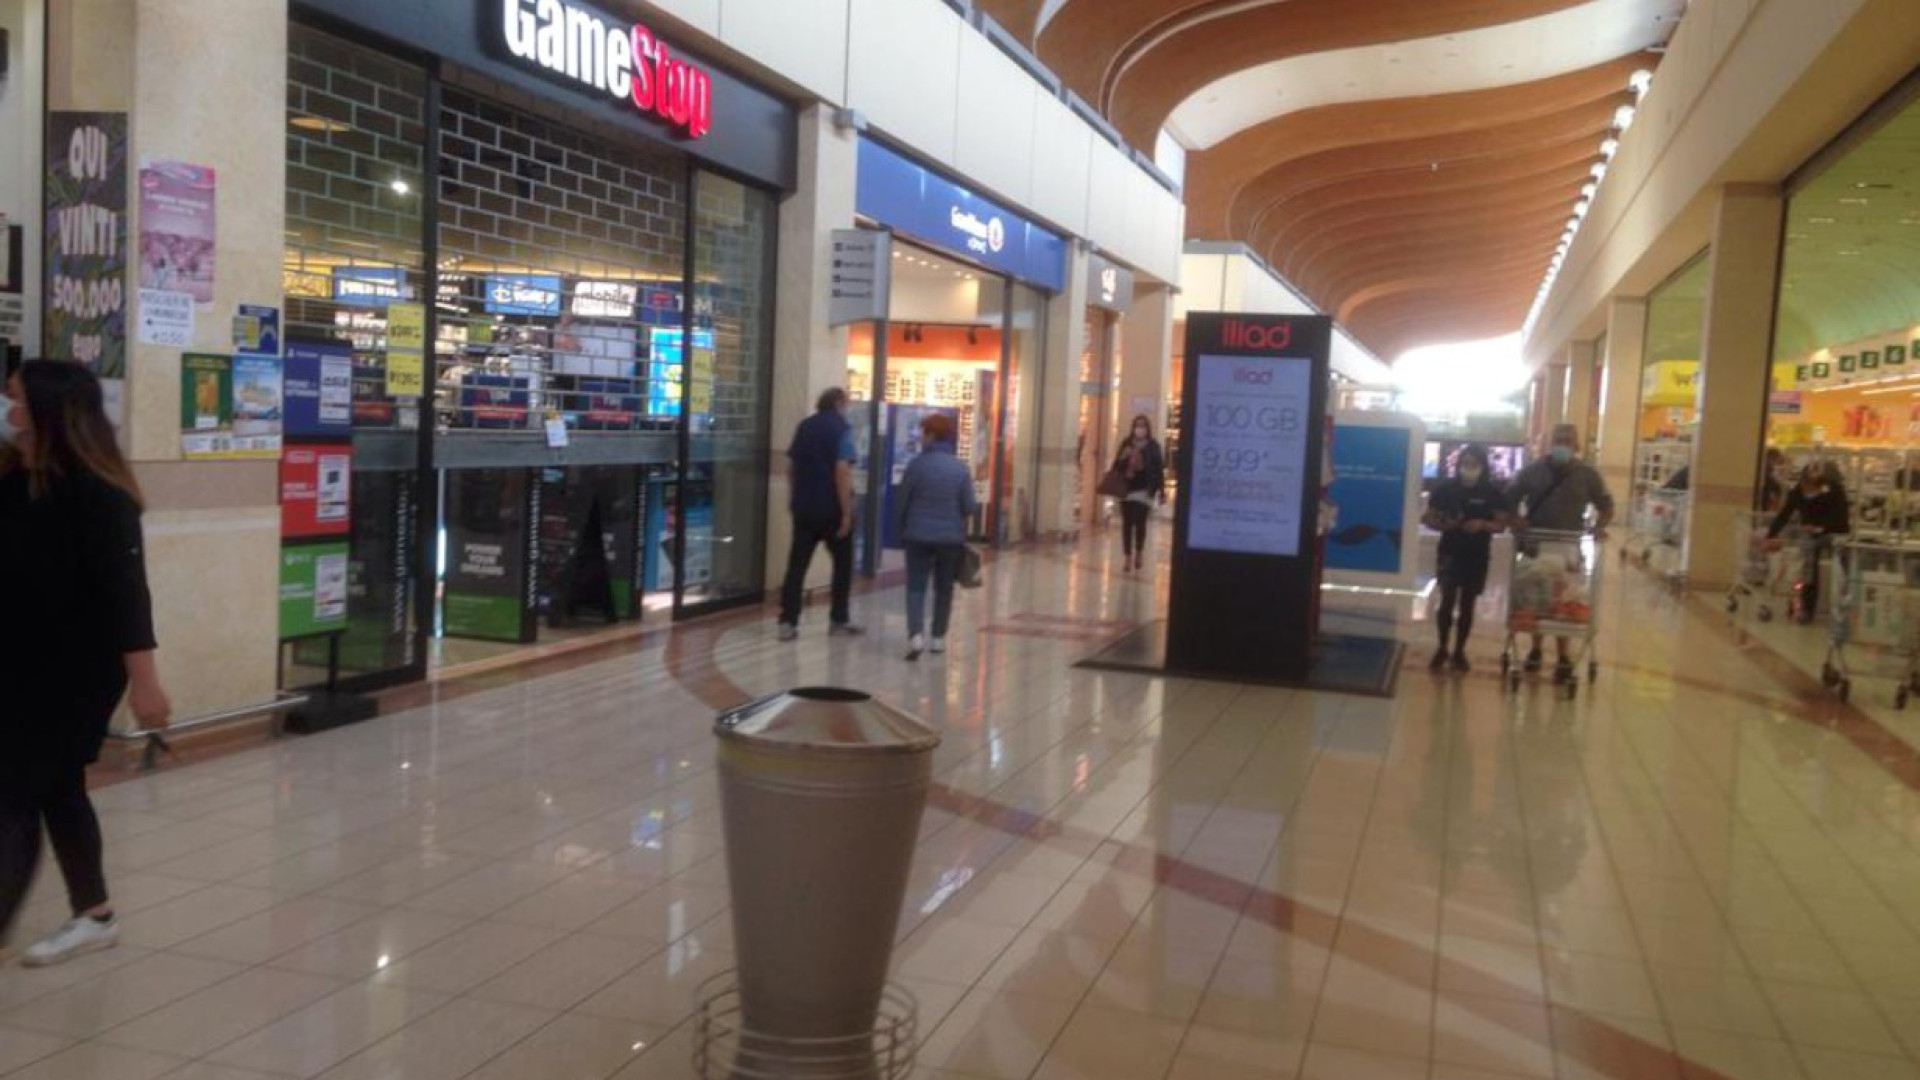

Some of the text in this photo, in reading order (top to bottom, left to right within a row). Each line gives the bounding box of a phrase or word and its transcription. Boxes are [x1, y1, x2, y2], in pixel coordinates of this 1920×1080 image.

[503, 0, 711, 138] GameStop
[69, 126, 107, 183] QUI
[59, 203, 118, 256] VINTI
[54, 275, 121, 319] 500.000
[1222, 319, 1292, 350] iliad
[1233, 367, 1273, 386] iliad
[1206, 404, 1297, 432] 100 GB
